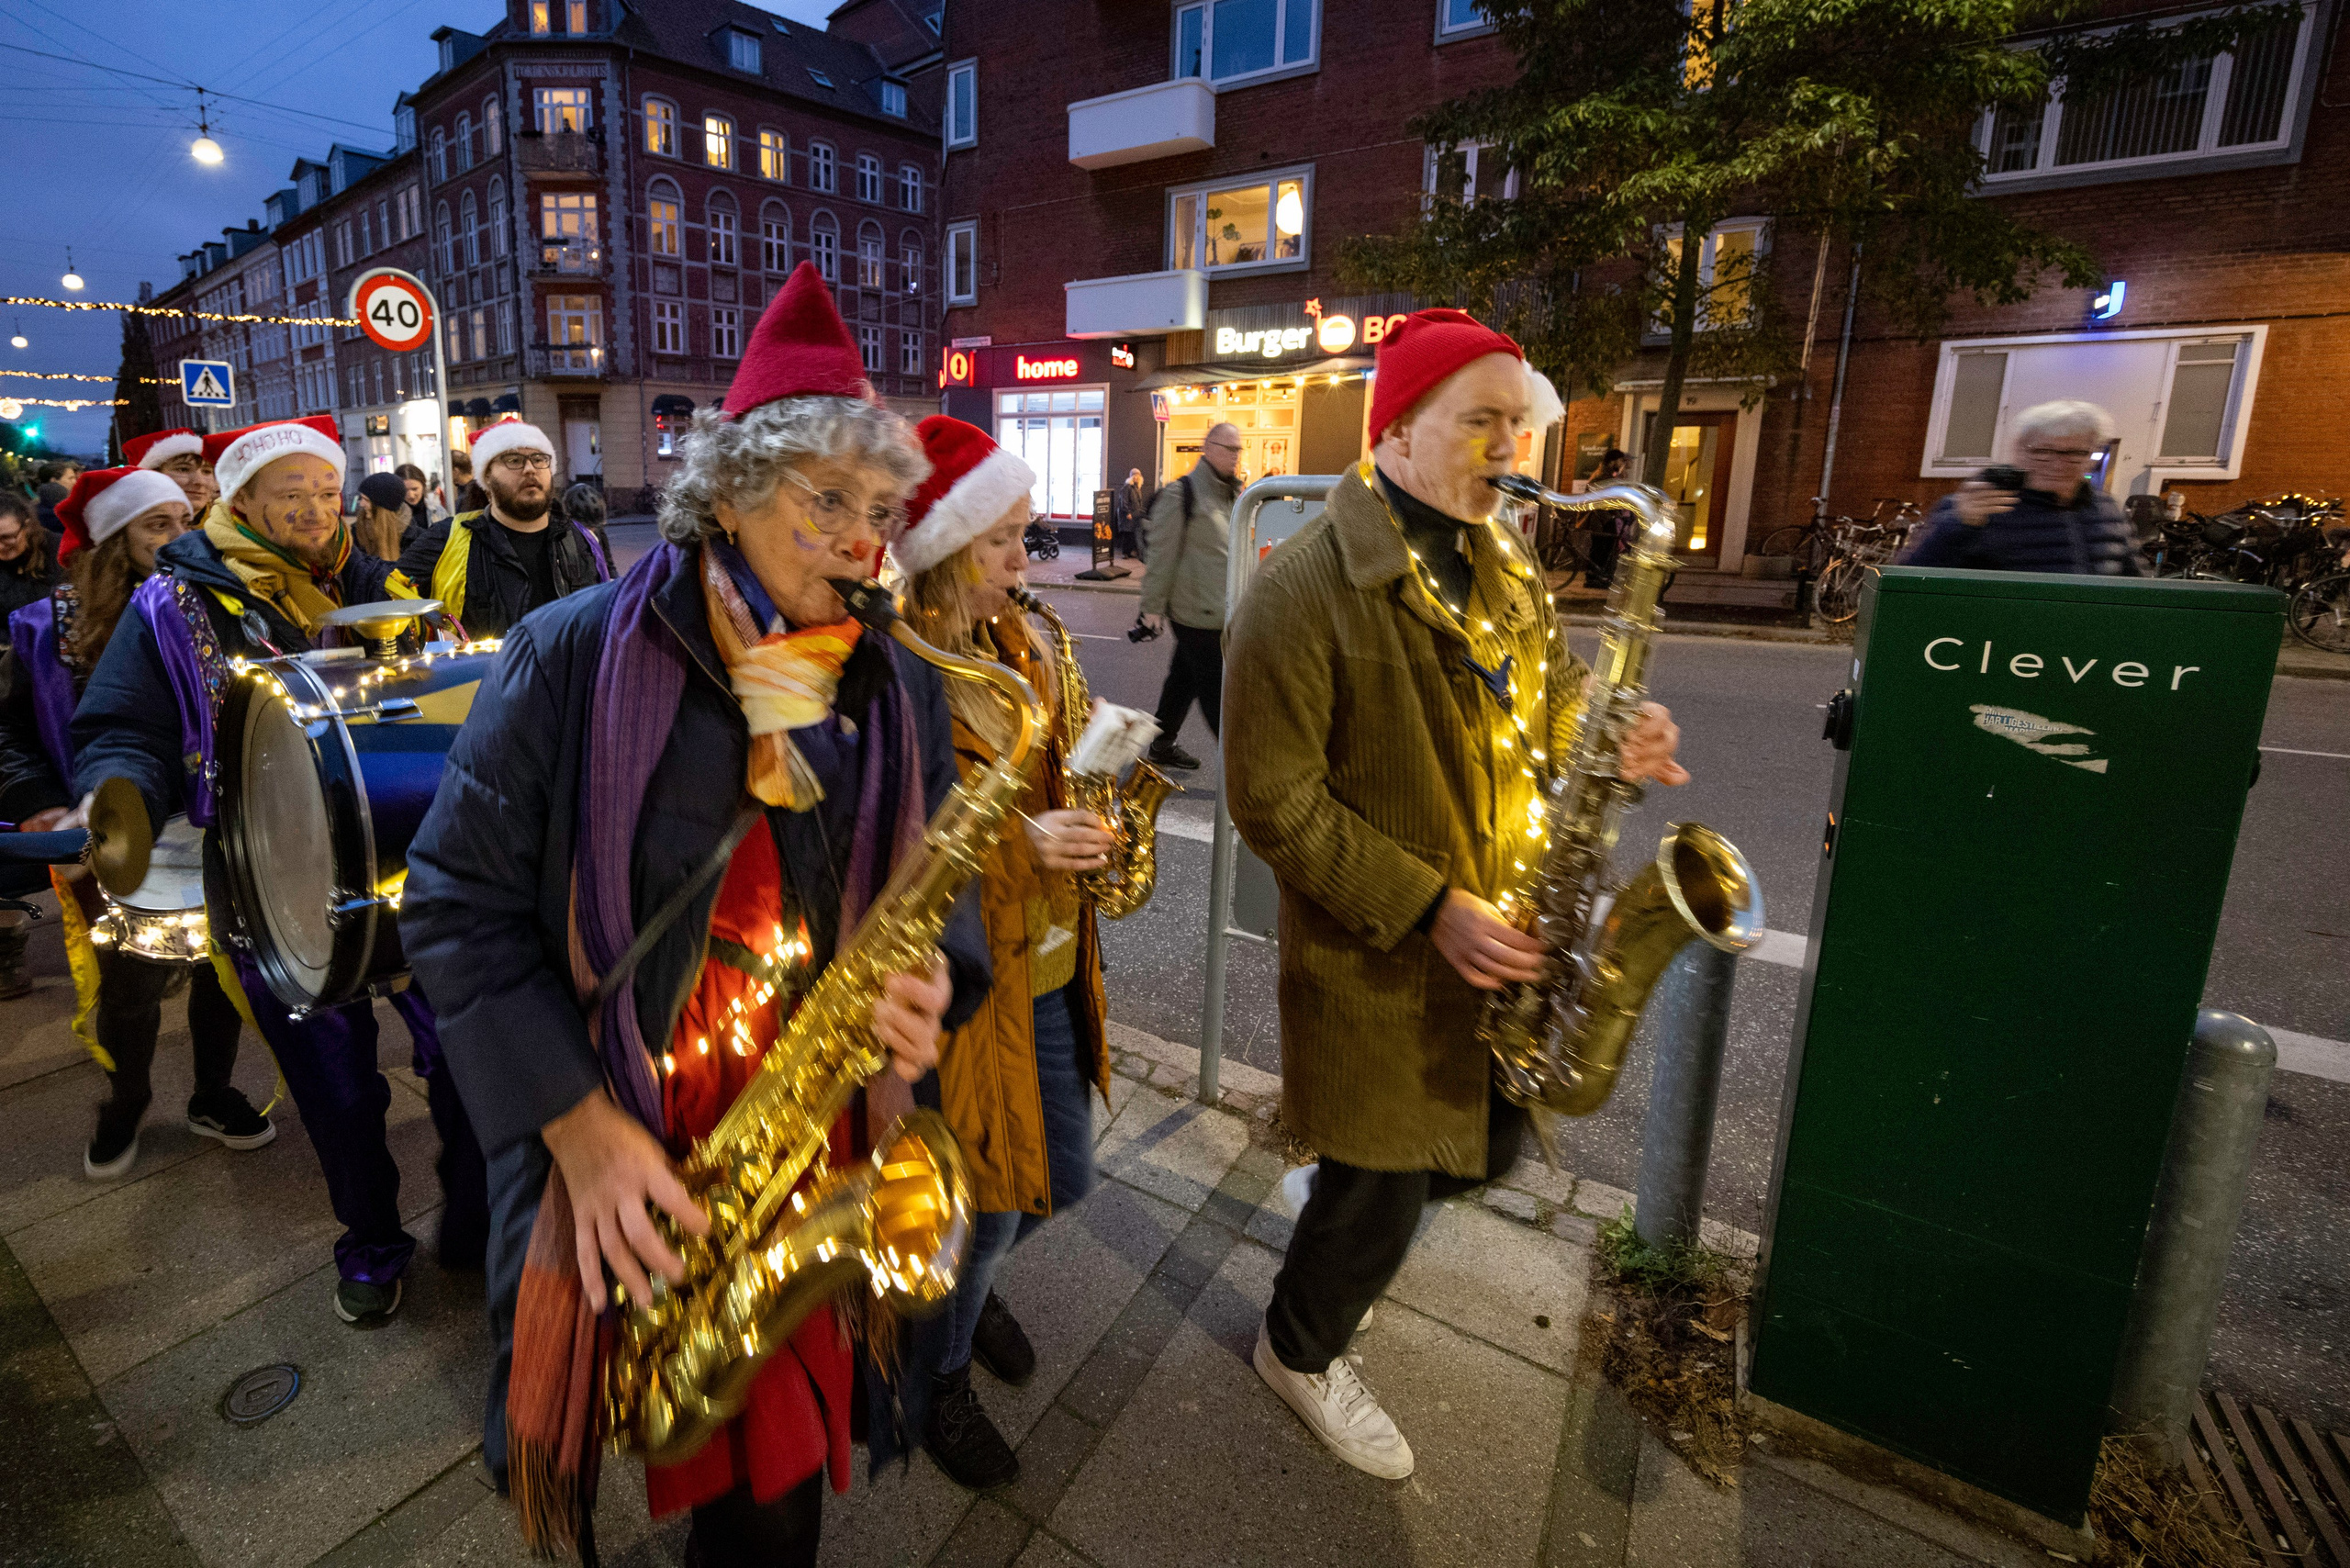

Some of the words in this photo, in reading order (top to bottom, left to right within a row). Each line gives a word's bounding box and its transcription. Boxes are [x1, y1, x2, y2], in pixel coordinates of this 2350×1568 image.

[372, 299, 420, 329] 40
[1216, 327, 1313, 358] Burger
[1016, 354, 1079, 380] home
[1924, 637, 2200, 690] Clever
